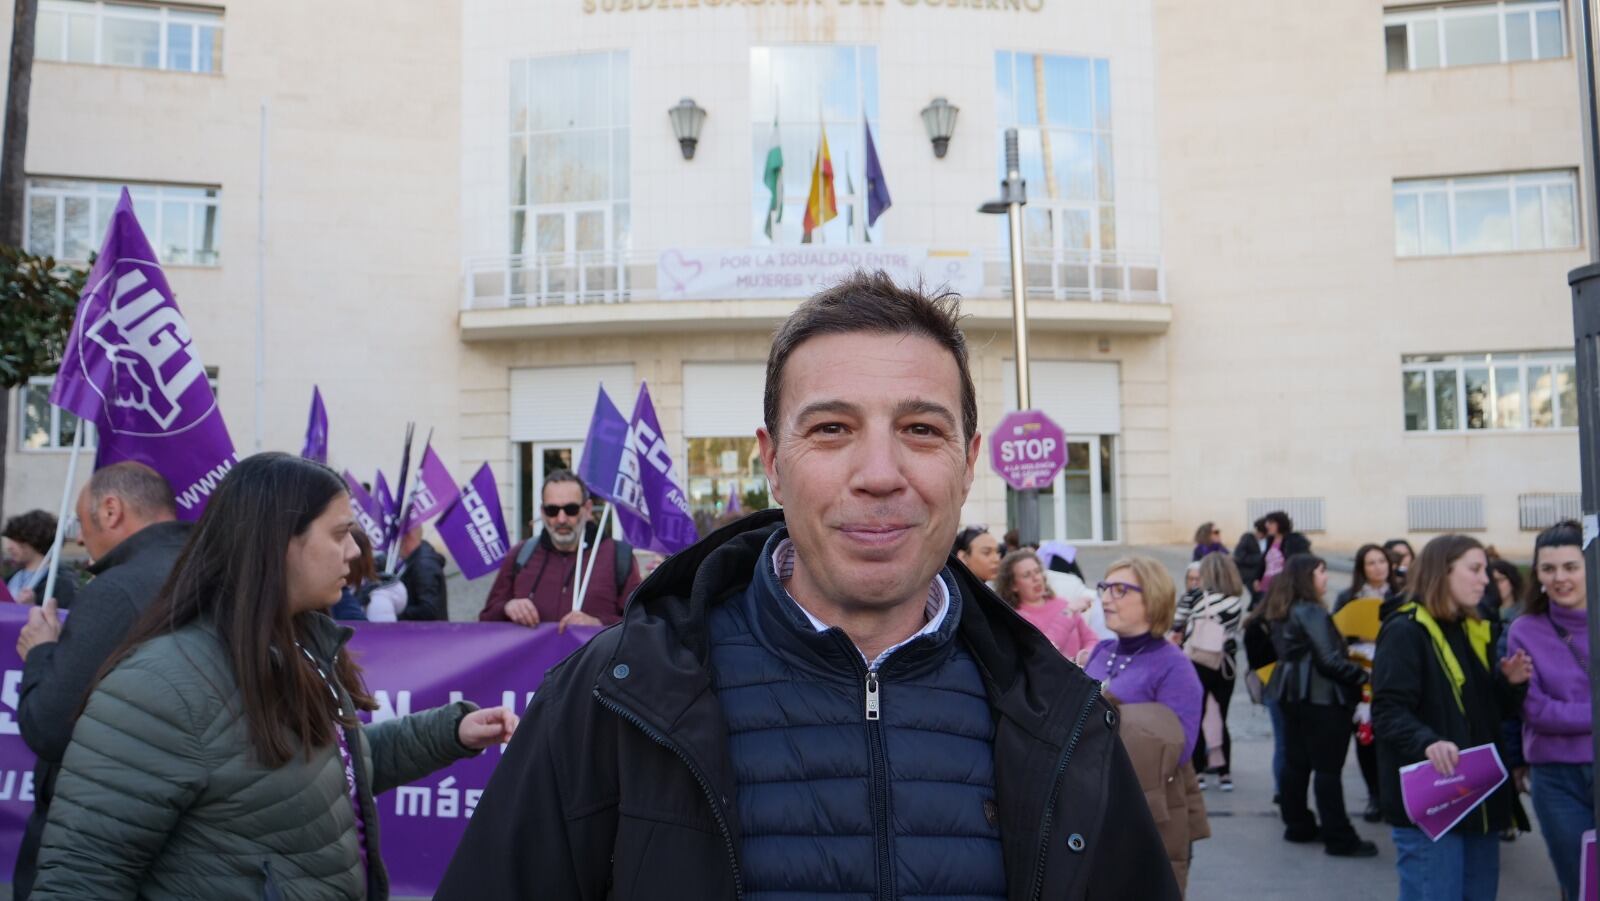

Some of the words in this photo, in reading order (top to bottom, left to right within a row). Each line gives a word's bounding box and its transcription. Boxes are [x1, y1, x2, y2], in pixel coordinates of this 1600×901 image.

[720, 255, 750, 269] POR
[756, 255, 776, 268] LA
[780, 252, 862, 268] IGUALDAD
[866, 252, 909, 268] ENTRE
[736, 273, 804, 289] MUJERES
[110, 268, 204, 401] UGT
[1001, 437, 1057, 462] STOP
[395, 775, 485, 819] más
